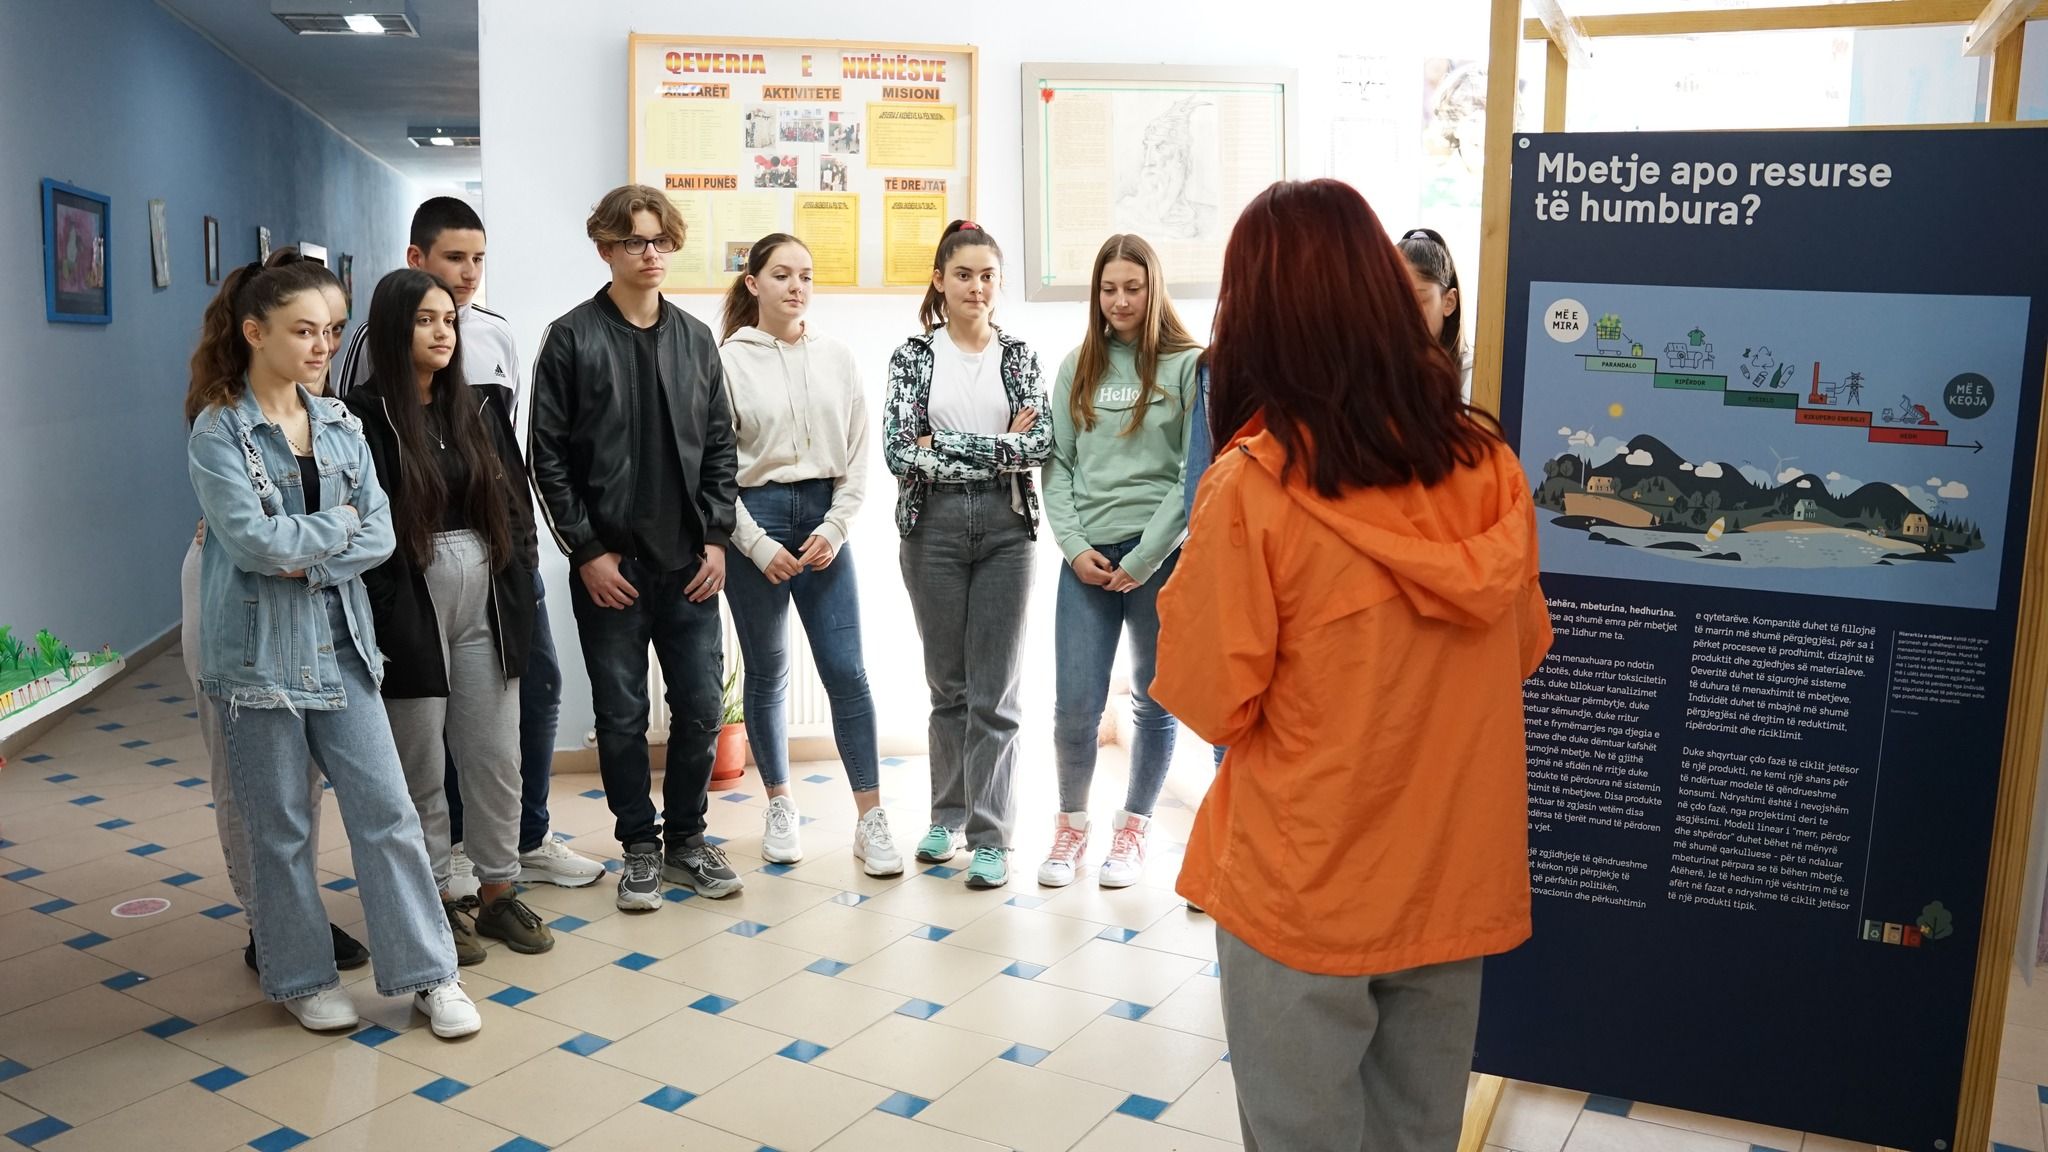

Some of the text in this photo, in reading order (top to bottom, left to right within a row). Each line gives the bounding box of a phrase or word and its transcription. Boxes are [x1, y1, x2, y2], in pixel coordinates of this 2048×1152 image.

[666, 52, 946, 82] QEVERIA E NXËNËSVE
[763, 88, 840, 99] AKTIVITETE
[882, 87, 940, 100] MISIONI
[1537, 152, 1892, 193] Mbetje apo resurse
[665, 178, 694, 188] PLANI
[698, 178, 700, 188] I
[885, 178, 946, 191] TË DREJTAT
[1535, 190, 1761, 225] të humbura?
[1555, 309, 1578, 319] MË E
[1552, 321, 1579, 330] MIRA
[1099, 387, 1139, 402] Hello
[1957, 382, 1984, 395] MË E
[1949, 396, 1988, 407] KEQJA
[1580, 602, 1627, 614] mbeturina,
[1630, 605, 1676, 617] hedhurina.
[1563, 614, 1677, 633] aq shumë emra për mbetjet
[1572, 627, 1598, 637] lidhur
[1614, 632, 1624, 640] ta.
[1703, 613, 1750, 624] qytetarëve.
[1753, 616, 1800, 629] Kompanitë
[1802, 621, 1828, 631] duhet
[1830, 624, 1839, 632] të
[1842, 624, 1876, 636] fillojnë
[1694, 625, 1703, 634] të
[1705, 627, 1734, 636] marrin
[1736, 629, 1750, 638] më
[1752, 630, 1781, 641] shumë
[1783, 633, 1837, 647] përgjegjësi,
[1840, 639, 1855, 648] për
[1693, 639, 1874, 664] përket proceseve të prodhimit, dizajnit të
[1563, 655, 1612, 666] menaxhuara
[1614, 660, 1625, 668] po
[1627, 660, 1654, 670] ndotin
[1692, 653, 1865, 677] produktit dhe zgjedhjes së materialeve.
[1546, 665, 1570, 676] botës,
[1573, 668, 1593, 678] duke
[1595, 670, 1616, 680] rritur
[1618, 673, 1666, 685] toksicitetin
[1691, 666, 1846, 689] Qeveritë duhet të sigurojnë sisteme
[1548, 679, 1657, 698] duke bllokuar kanalizimet
[1690, 680, 1851, 704] të duhura të menaxhimit të mbetjeve.
[1541, 692, 1649, 710] shkaktuar përmbytje, duke
[1688, 692, 1849, 718] Individët duhet të mbajnë më shumë
[1551, 706, 1639, 723] sëmundje, duke rritur
[1686, 707, 1847, 732] përgjegjësi në drejtim të reduktimit,
[1551, 719, 1605, 734] frymëmarrjes
[1608, 727, 1623, 736] nga
[1625, 728, 1652, 739] djegia
[1685, 720, 1803, 740] ripërdorimit dhe riciklimit.
[1683, 746, 1859, 774] Duke shqyrtuar çdo fazë të ciklit jetësor
[1682, 760, 1690, 769] të
[1692, 762, 1706, 772] një
[1708, 765, 1748, 776] produkti,
[1764, 769, 1786, 780] kemi
[1788, 773, 1803, 783] një
[1805, 774, 1831, 785] shans
[1833, 778, 1848, 787] për
[1680, 774, 1837, 800] të ndërtuar modele të qëndrueshme
[1574, 892, 1646, 908] dhe përkushtimin
[1668, 891, 1756, 911] të një produkti tipik.
[1669, 879, 1689, 888] afërt
[1692, 882, 1702, 890] në
[1705, 882, 1725, 893] fazat
[1735, 888, 1778, 901] ndryshme
[1780, 894, 1789, 902] të
[1791, 895, 1816, 906] ciklit
[1817, 898, 1850, 910] jetësor
